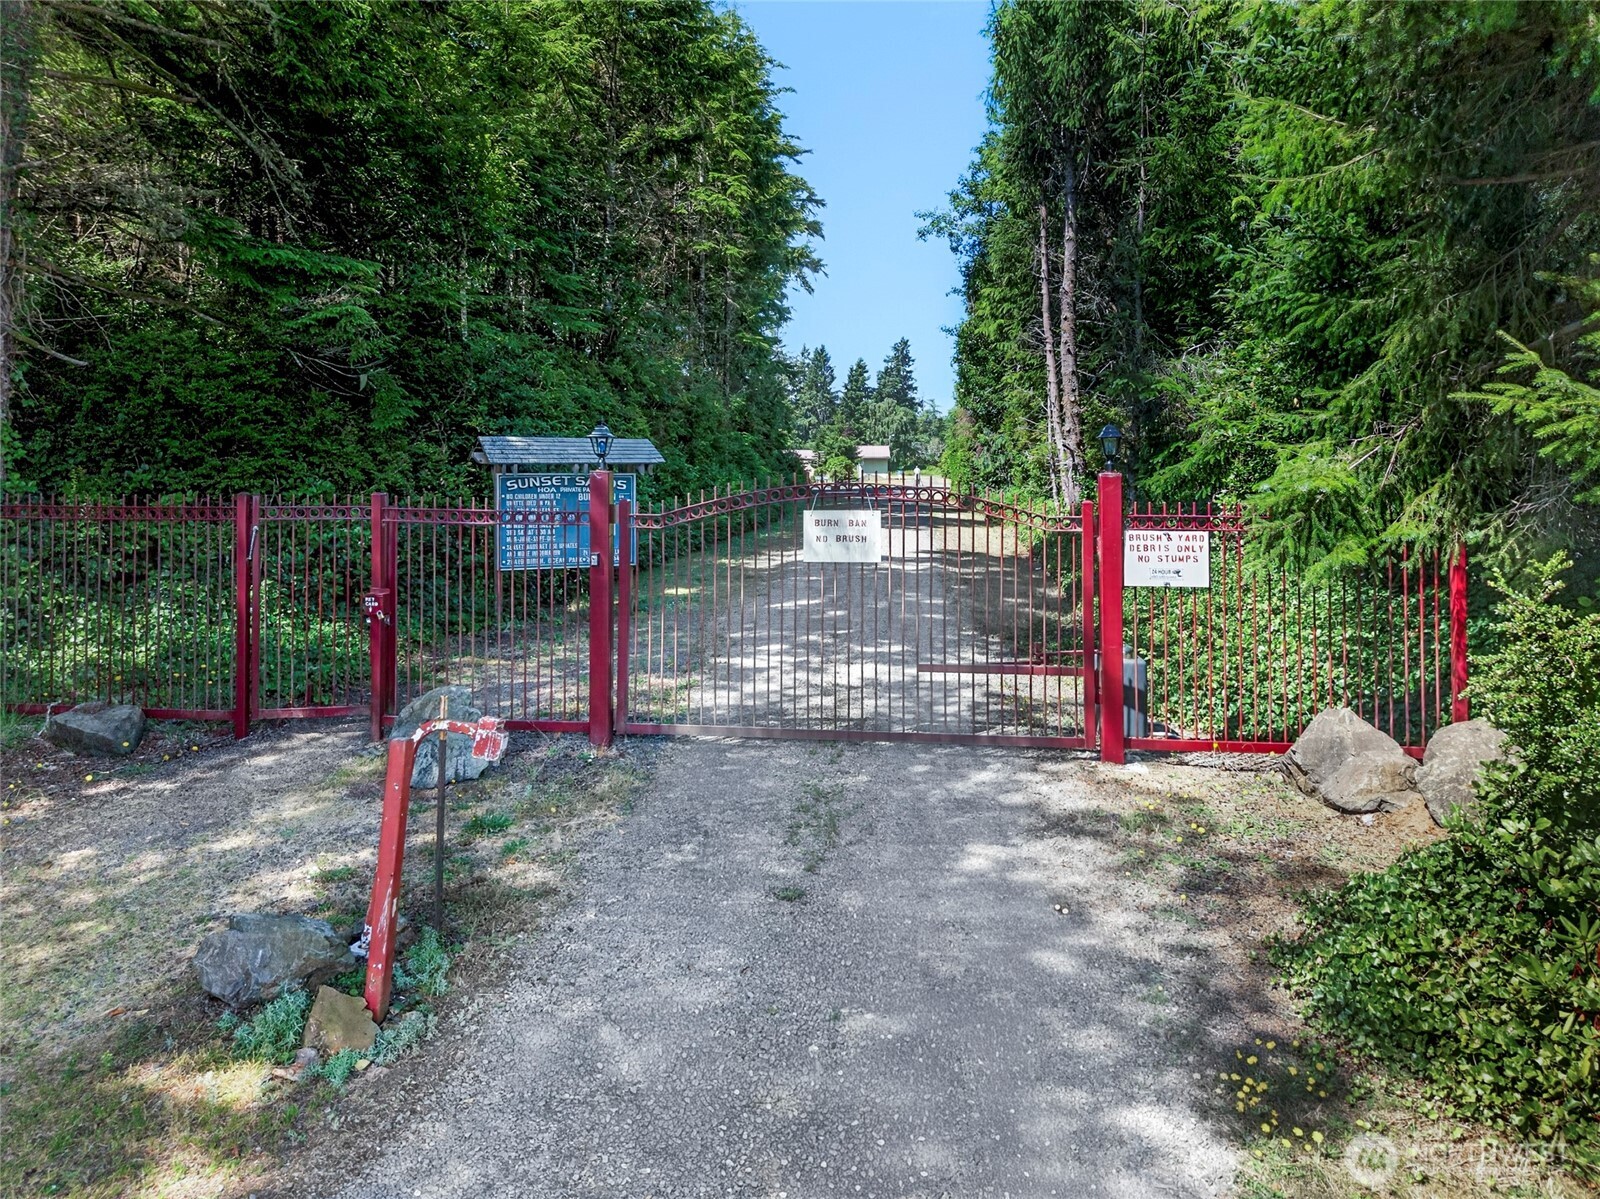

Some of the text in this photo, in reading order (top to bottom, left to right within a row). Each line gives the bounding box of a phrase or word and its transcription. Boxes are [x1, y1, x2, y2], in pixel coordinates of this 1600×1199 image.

[506, 475, 570, 490] SUNSET
[814, 519, 867, 527] BURN BAN
[816, 534, 867, 543] NO BRUSH
[1128, 533, 1162, 542] BRUSH
[1177, 534, 1205, 543] YARD
[1129, 544, 1204, 553] DEBRIS ONLY
[1138, 555, 1199, 563] NO STUMPS
